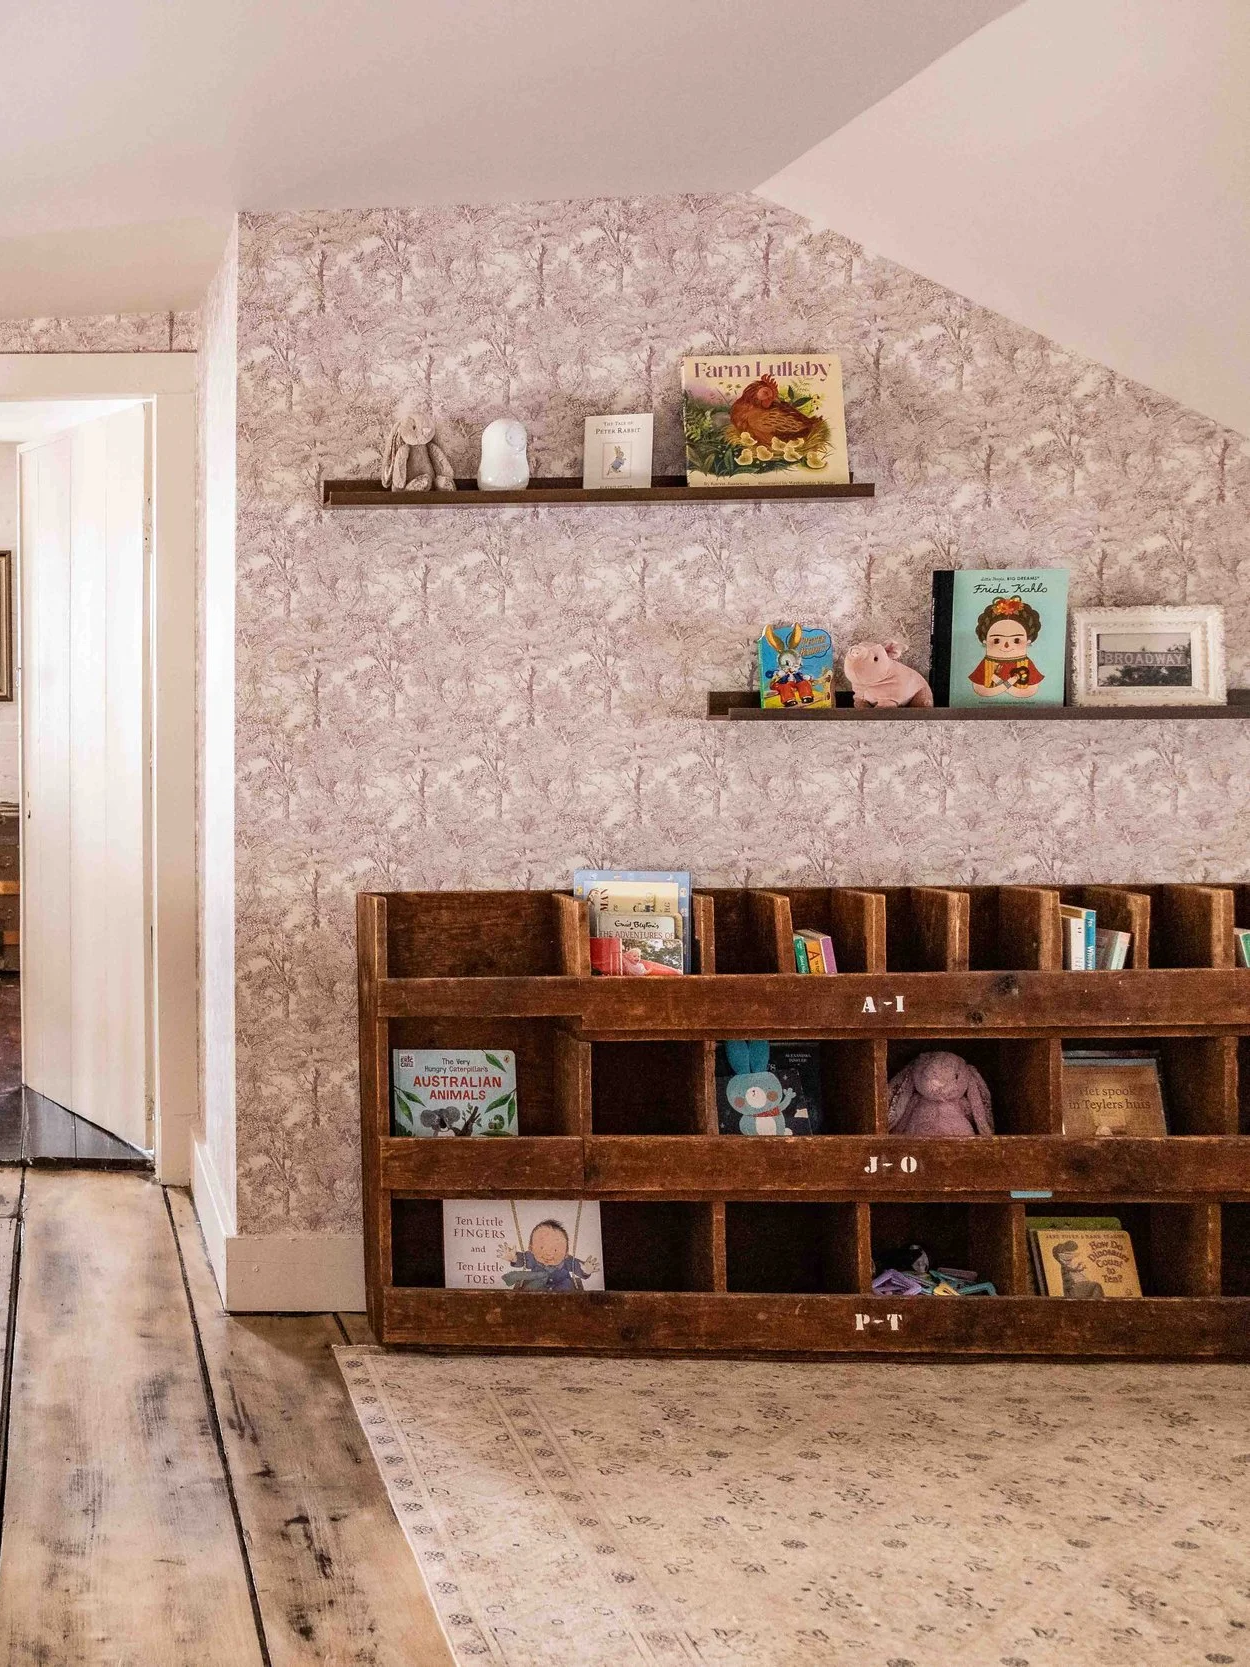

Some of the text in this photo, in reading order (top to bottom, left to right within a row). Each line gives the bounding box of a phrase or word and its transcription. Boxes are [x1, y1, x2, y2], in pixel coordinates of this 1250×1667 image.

[695, 361, 832, 381] Farm Lullaby
[973, 583, 1048, 594] Frida Kahlo
[1105, 653, 1182, 664] BROADWAY
[616, 931, 663, 939] ADVENTURES
[449, 1066, 488, 1074] Caterpillar's
[413, 1076, 502, 1087] AUSTRALIAN
[430, 1090, 486, 1100] ANIMALS
[1082, 1099, 1123, 1112] Teylers
[1125, 1099, 1150, 1109] huis
[455, 1217, 503, 1226] Ten Little
[454, 1229, 505, 1238] FINGERS
[1088, 1241, 1123, 1250] How Do
[456, 1262, 504, 1272] Ten Little
[1096, 1260, 1124, 1268] Count
[465, 1275, 495, 1284] TOES
[1102, 1275, 1123, 1283] Ten?
